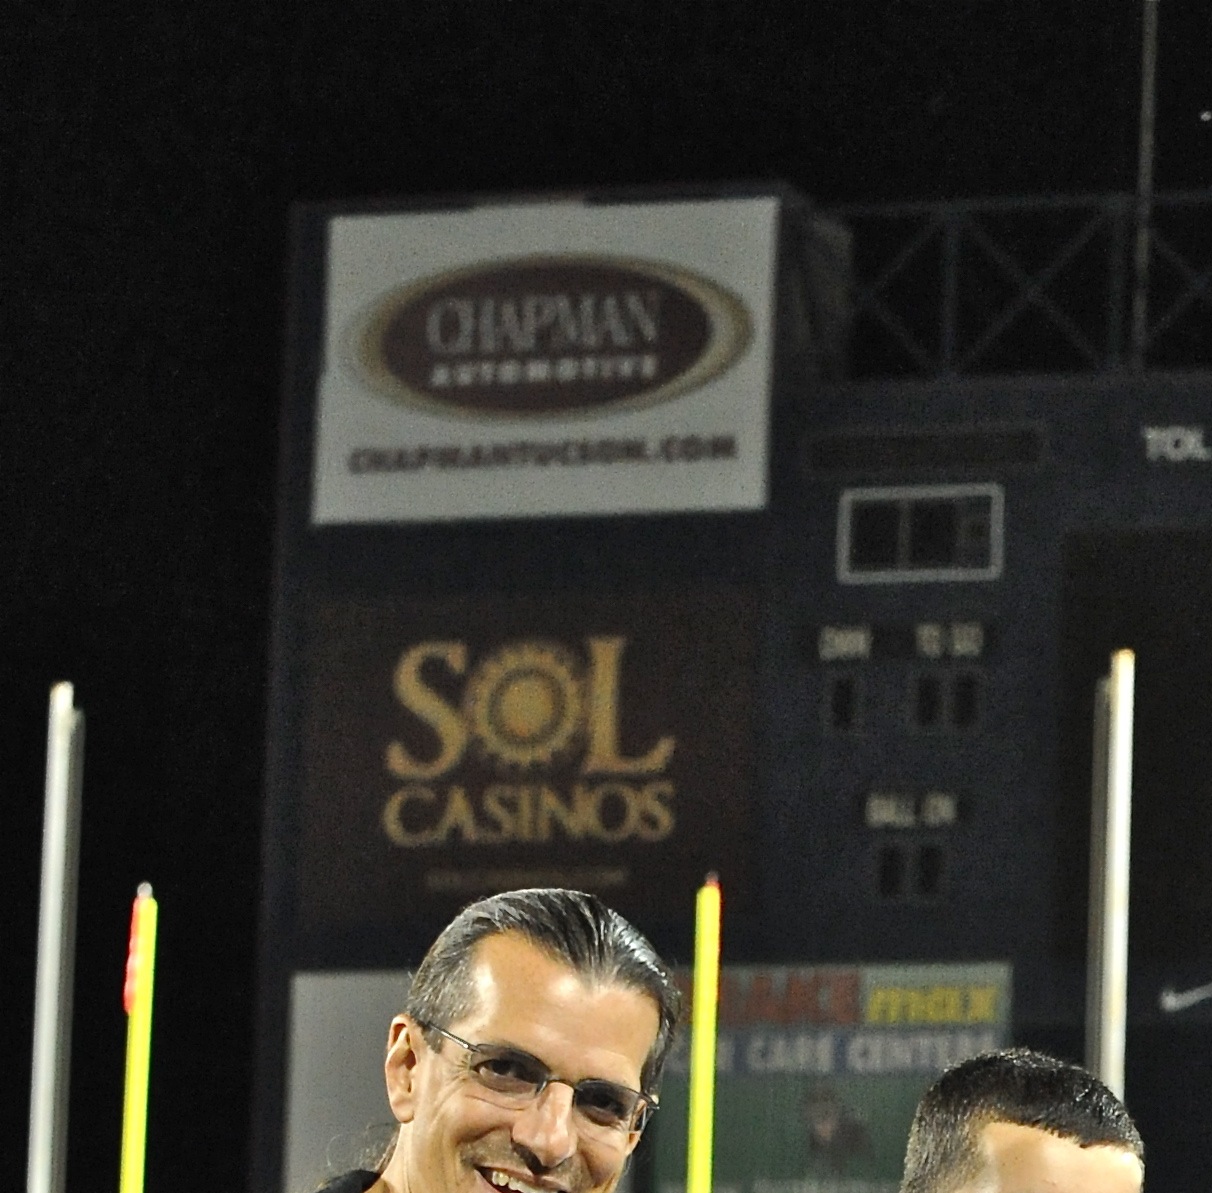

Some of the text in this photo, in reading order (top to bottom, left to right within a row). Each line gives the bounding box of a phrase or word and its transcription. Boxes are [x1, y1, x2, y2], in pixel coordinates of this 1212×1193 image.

[425, 290, 658, 354] CHAPMAN
[430, 353, 656, 389] AUTOMOTIVE
[386, 636, 677, 780] SOL
[384, 781, 676, 849] CASINOS
